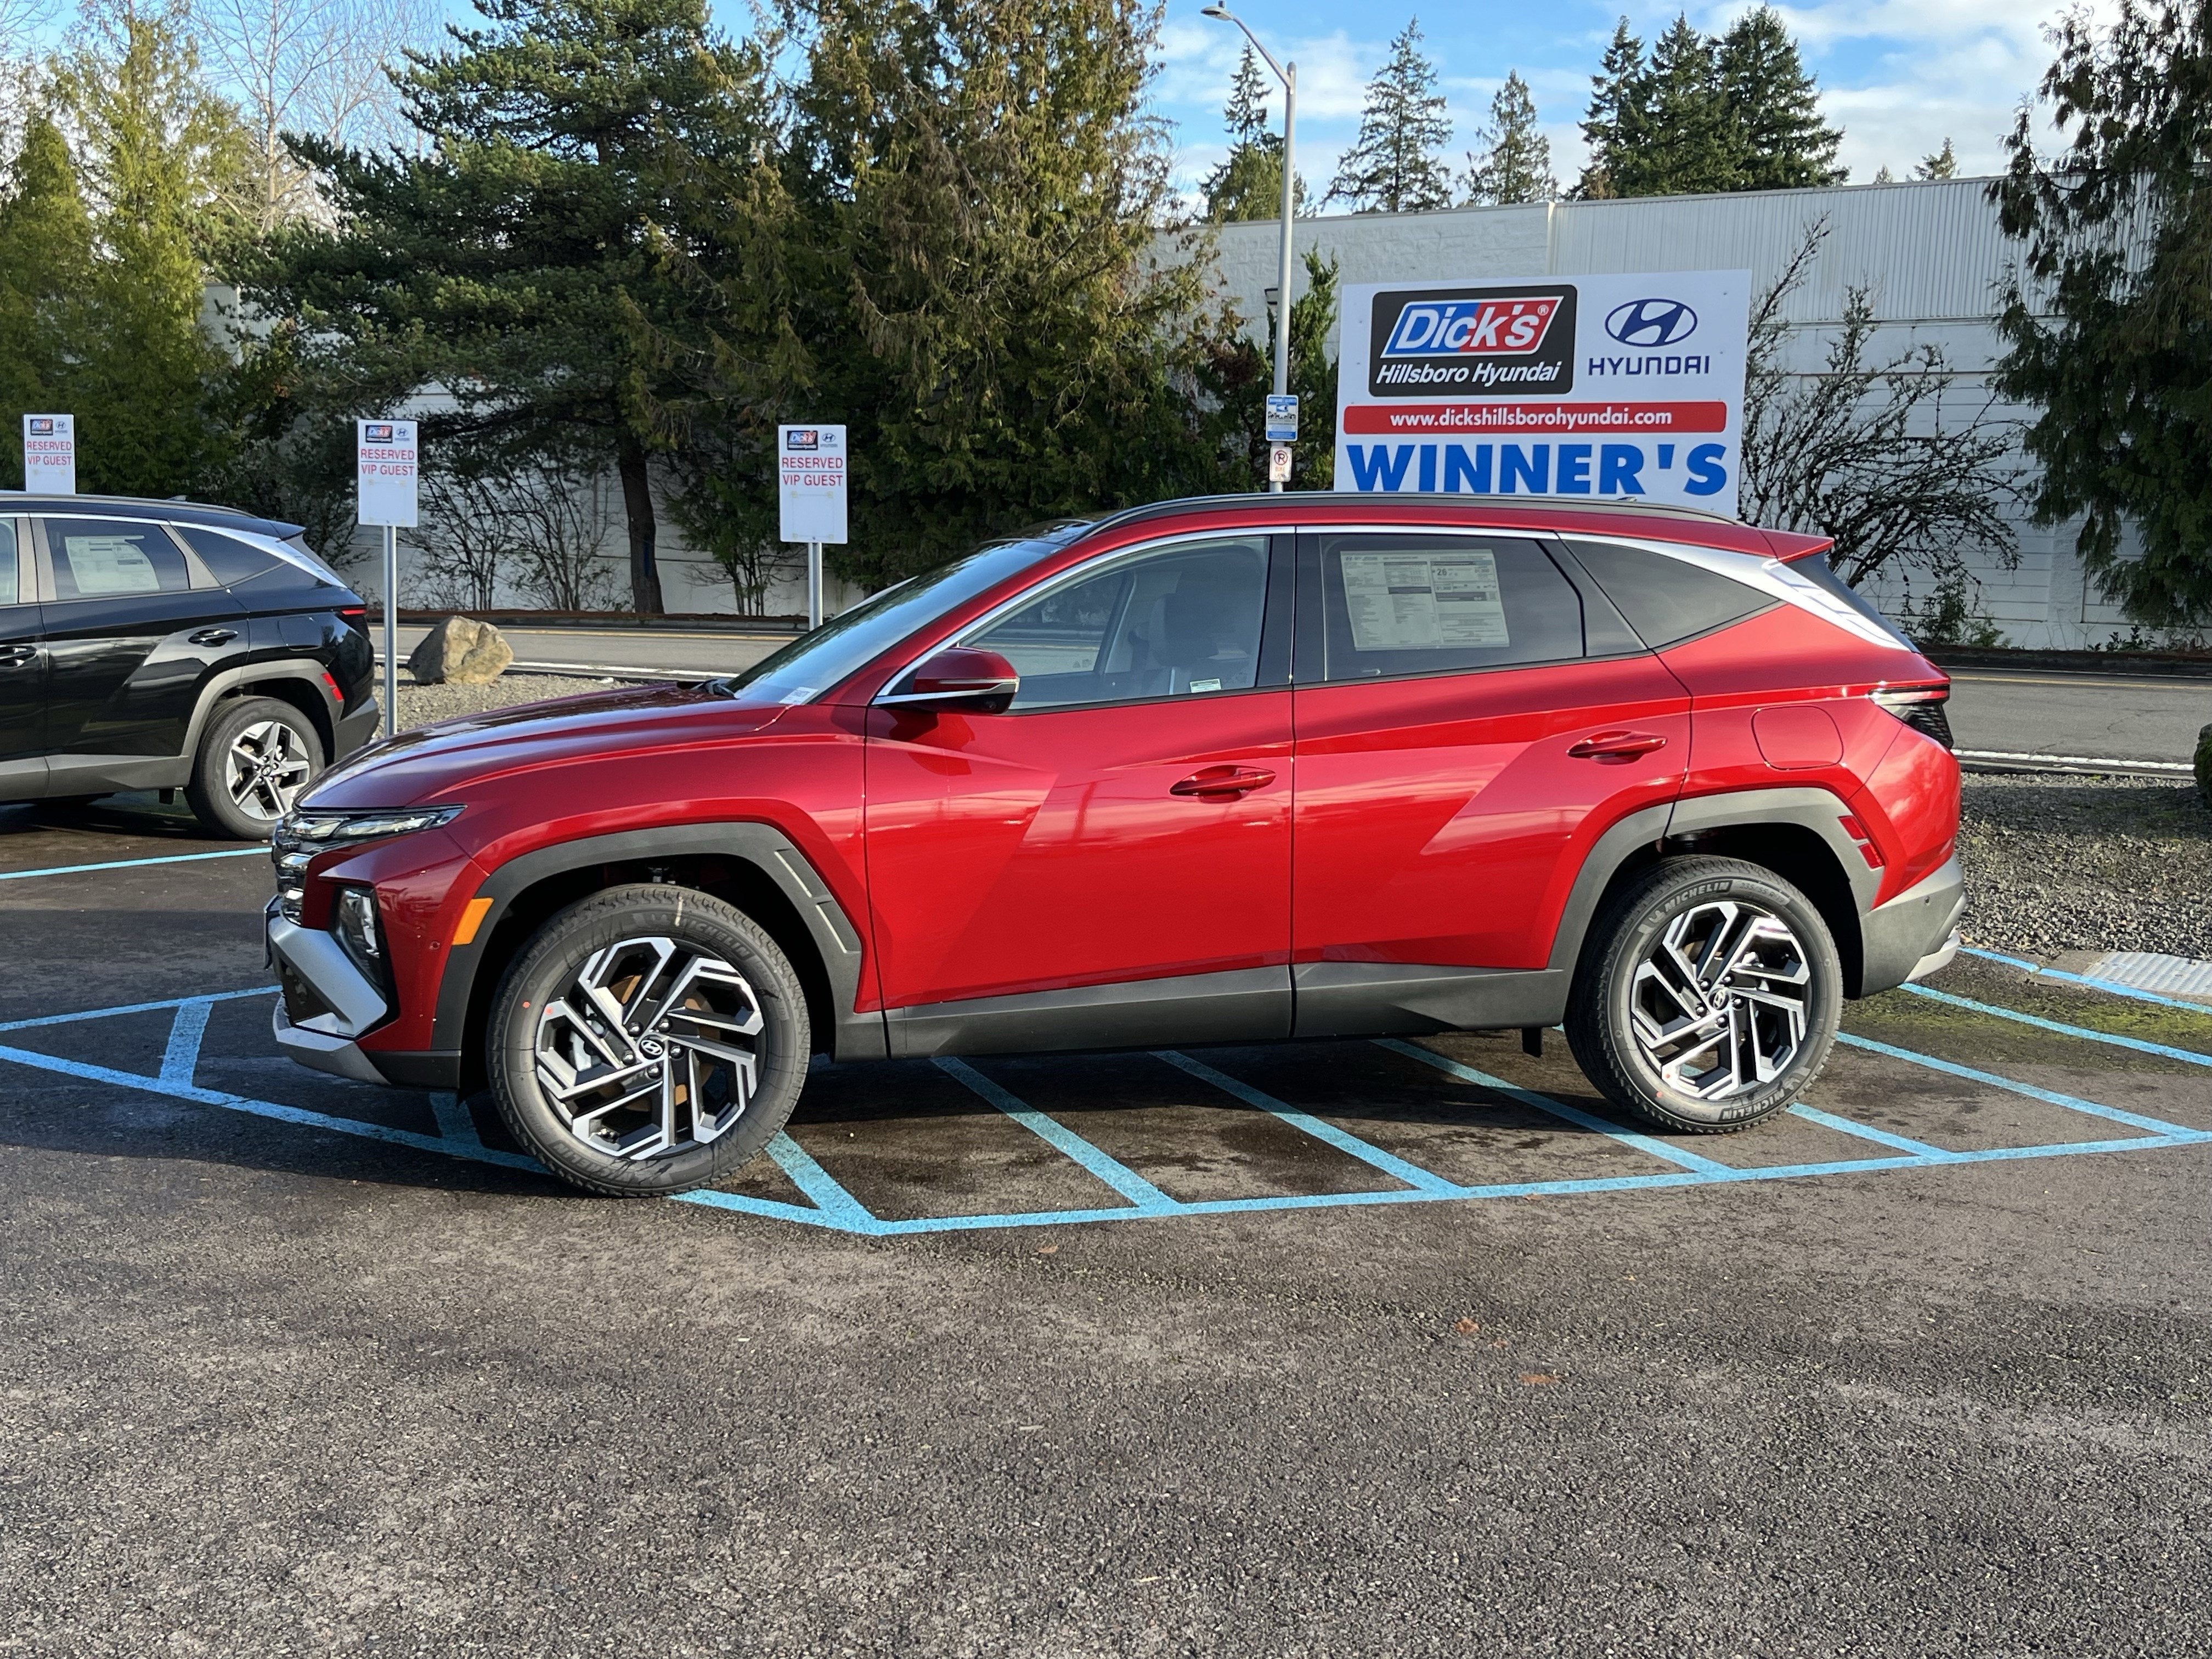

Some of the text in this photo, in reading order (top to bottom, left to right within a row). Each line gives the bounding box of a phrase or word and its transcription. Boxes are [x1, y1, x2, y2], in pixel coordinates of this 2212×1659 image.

[1395, 304, 1539, 349] Dick's
[1375, 360, 1562, 387] Hillsboro Hyundai
[1588, 356, 1710, 376] HYUNDAI
[1390, 407, 1672, 430] www.dickshillsborohyundai.com
[27, 441, 72, 450] RESERVED
[360, 448, 415, 460] RESERVED
[28, 456, 72, 466] VIP GUEST
[362, 465, 415, 476] VIP GUEST
[782, 457, 843, 469] RESERVED
[1346, 443, 1727, 495] WINNER'S
[783, 475, 843, 486] VIP GUEST
[1664, 881, 1730, 912] MICHELIN
[1722, 1088, 1785, 1120] MICHELIN
